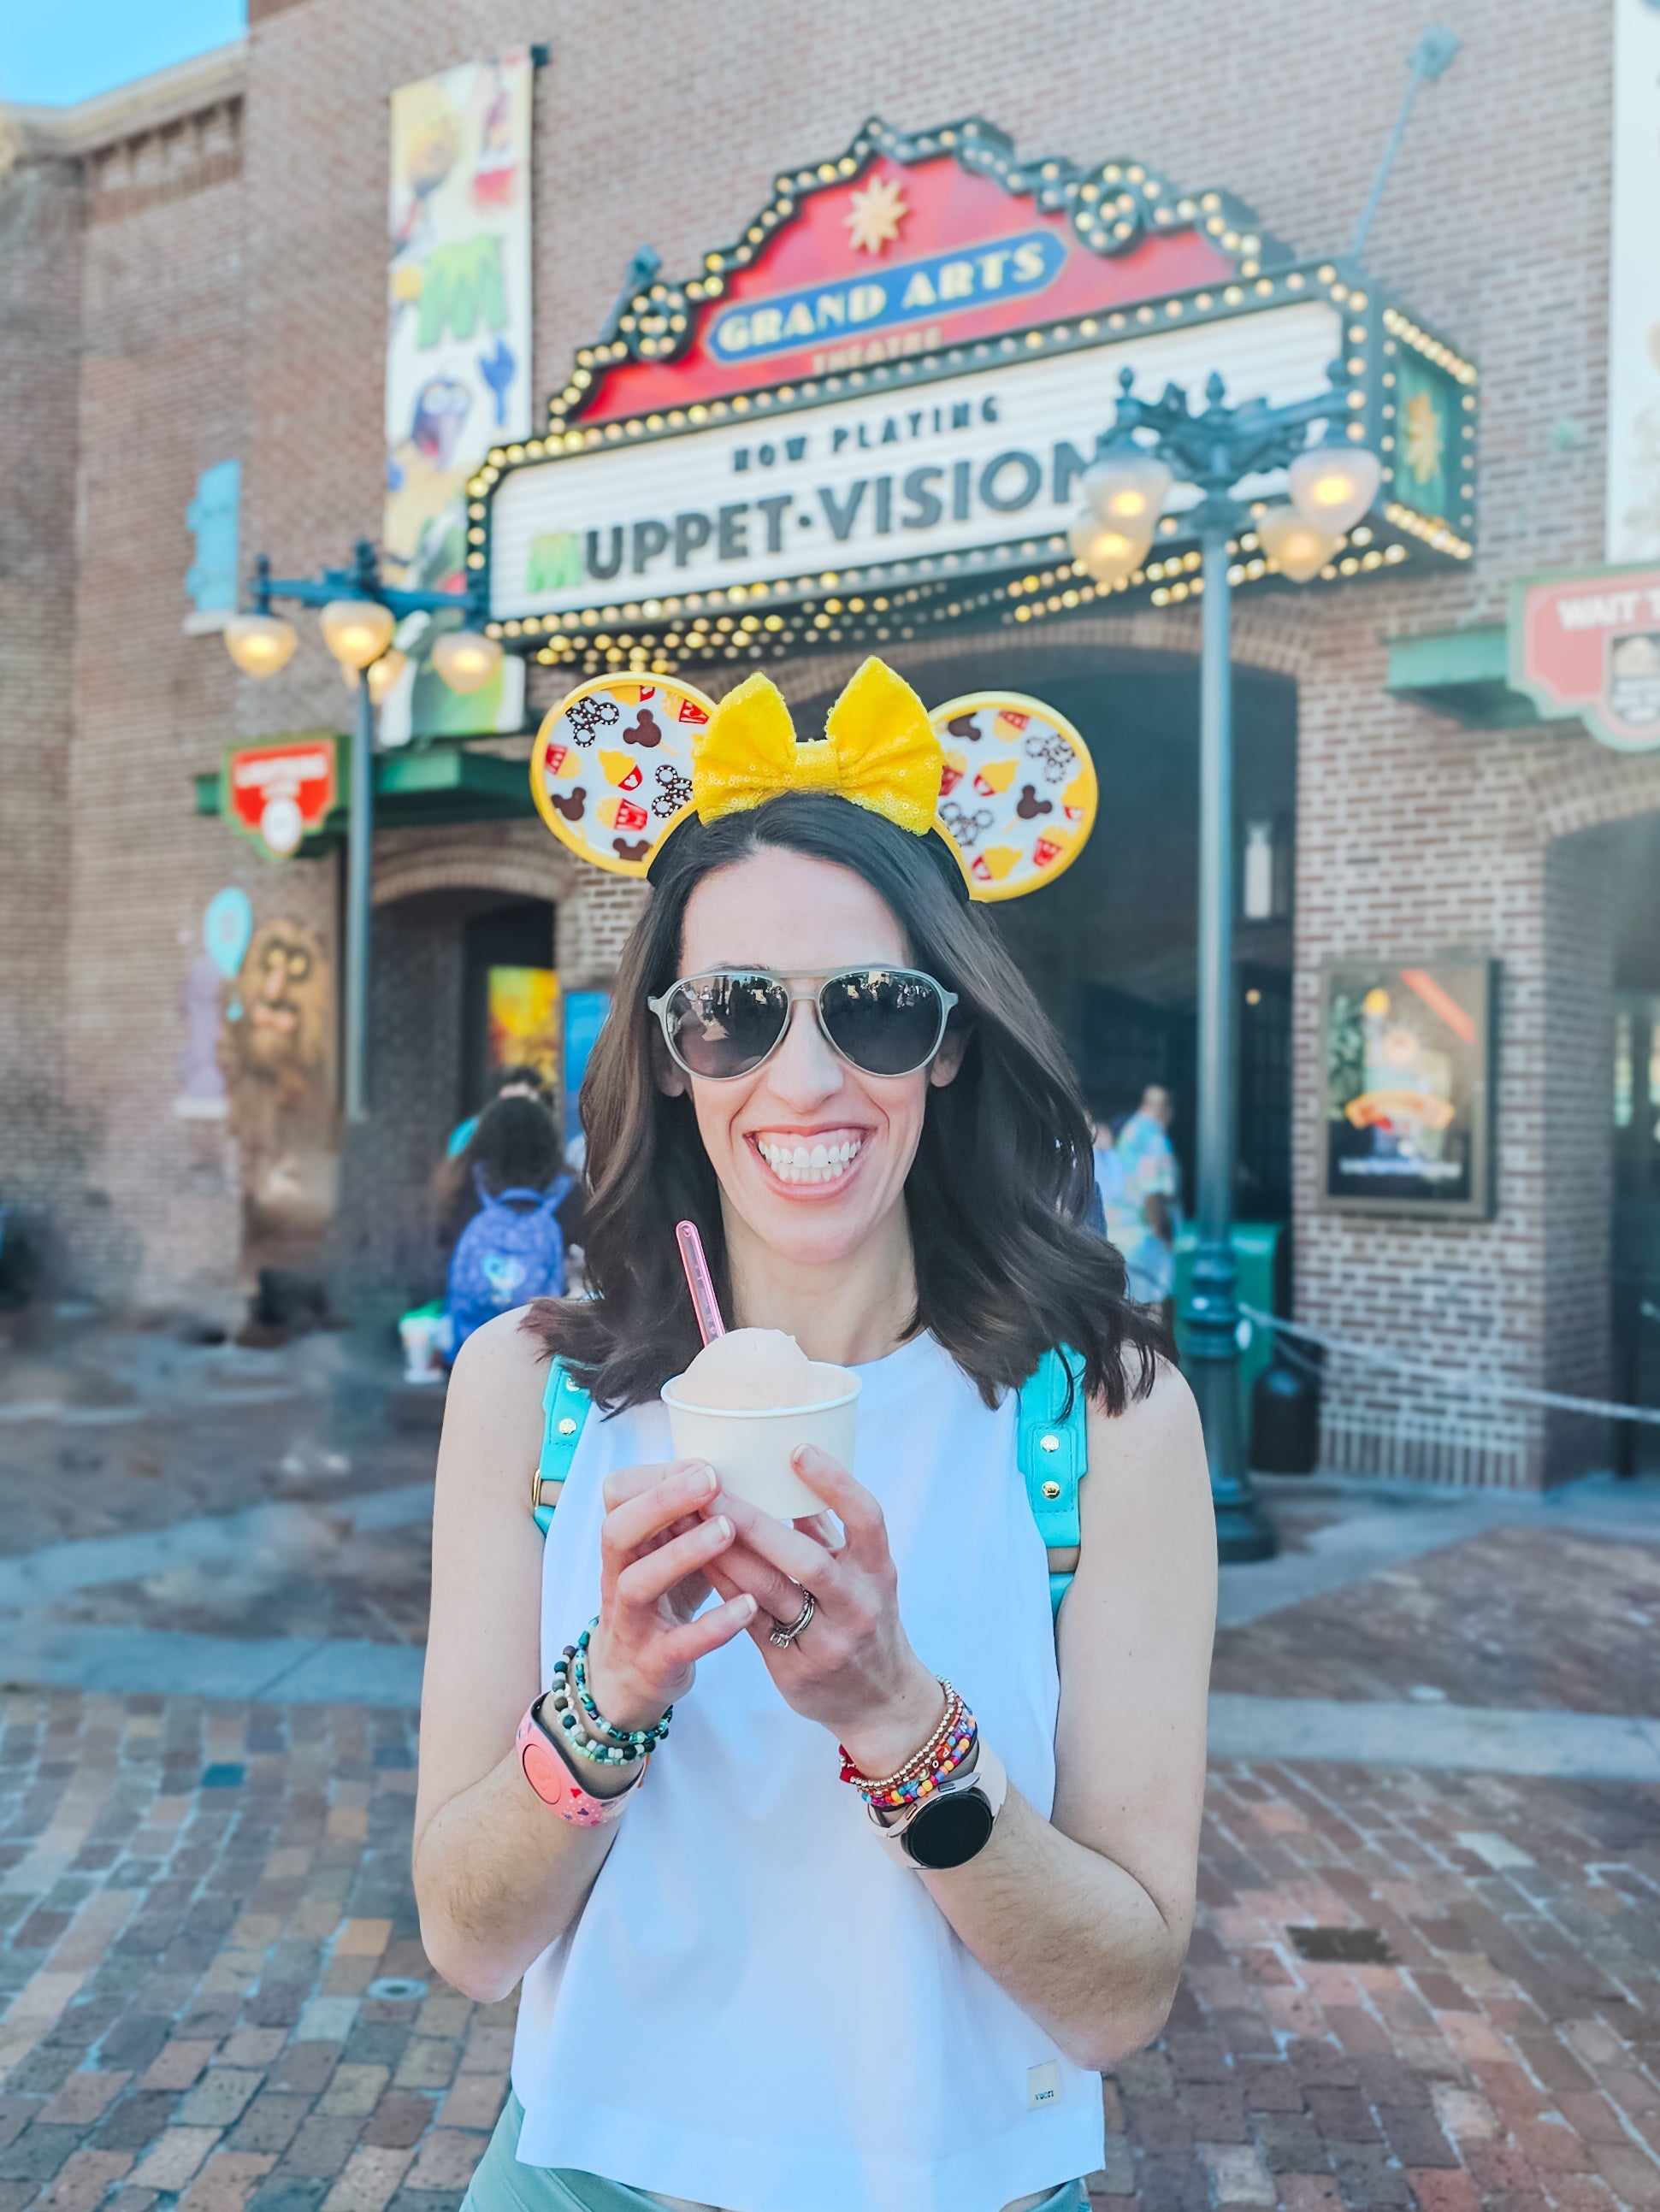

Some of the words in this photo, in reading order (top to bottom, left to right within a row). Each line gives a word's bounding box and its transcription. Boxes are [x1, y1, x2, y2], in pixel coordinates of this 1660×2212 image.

[718, 284, 887, 351] GRAND
[901, 242, 1045, 309] ARTS
[734, 436, 806, 471] NOW
[833, 396, 998, 453] PLAYING
